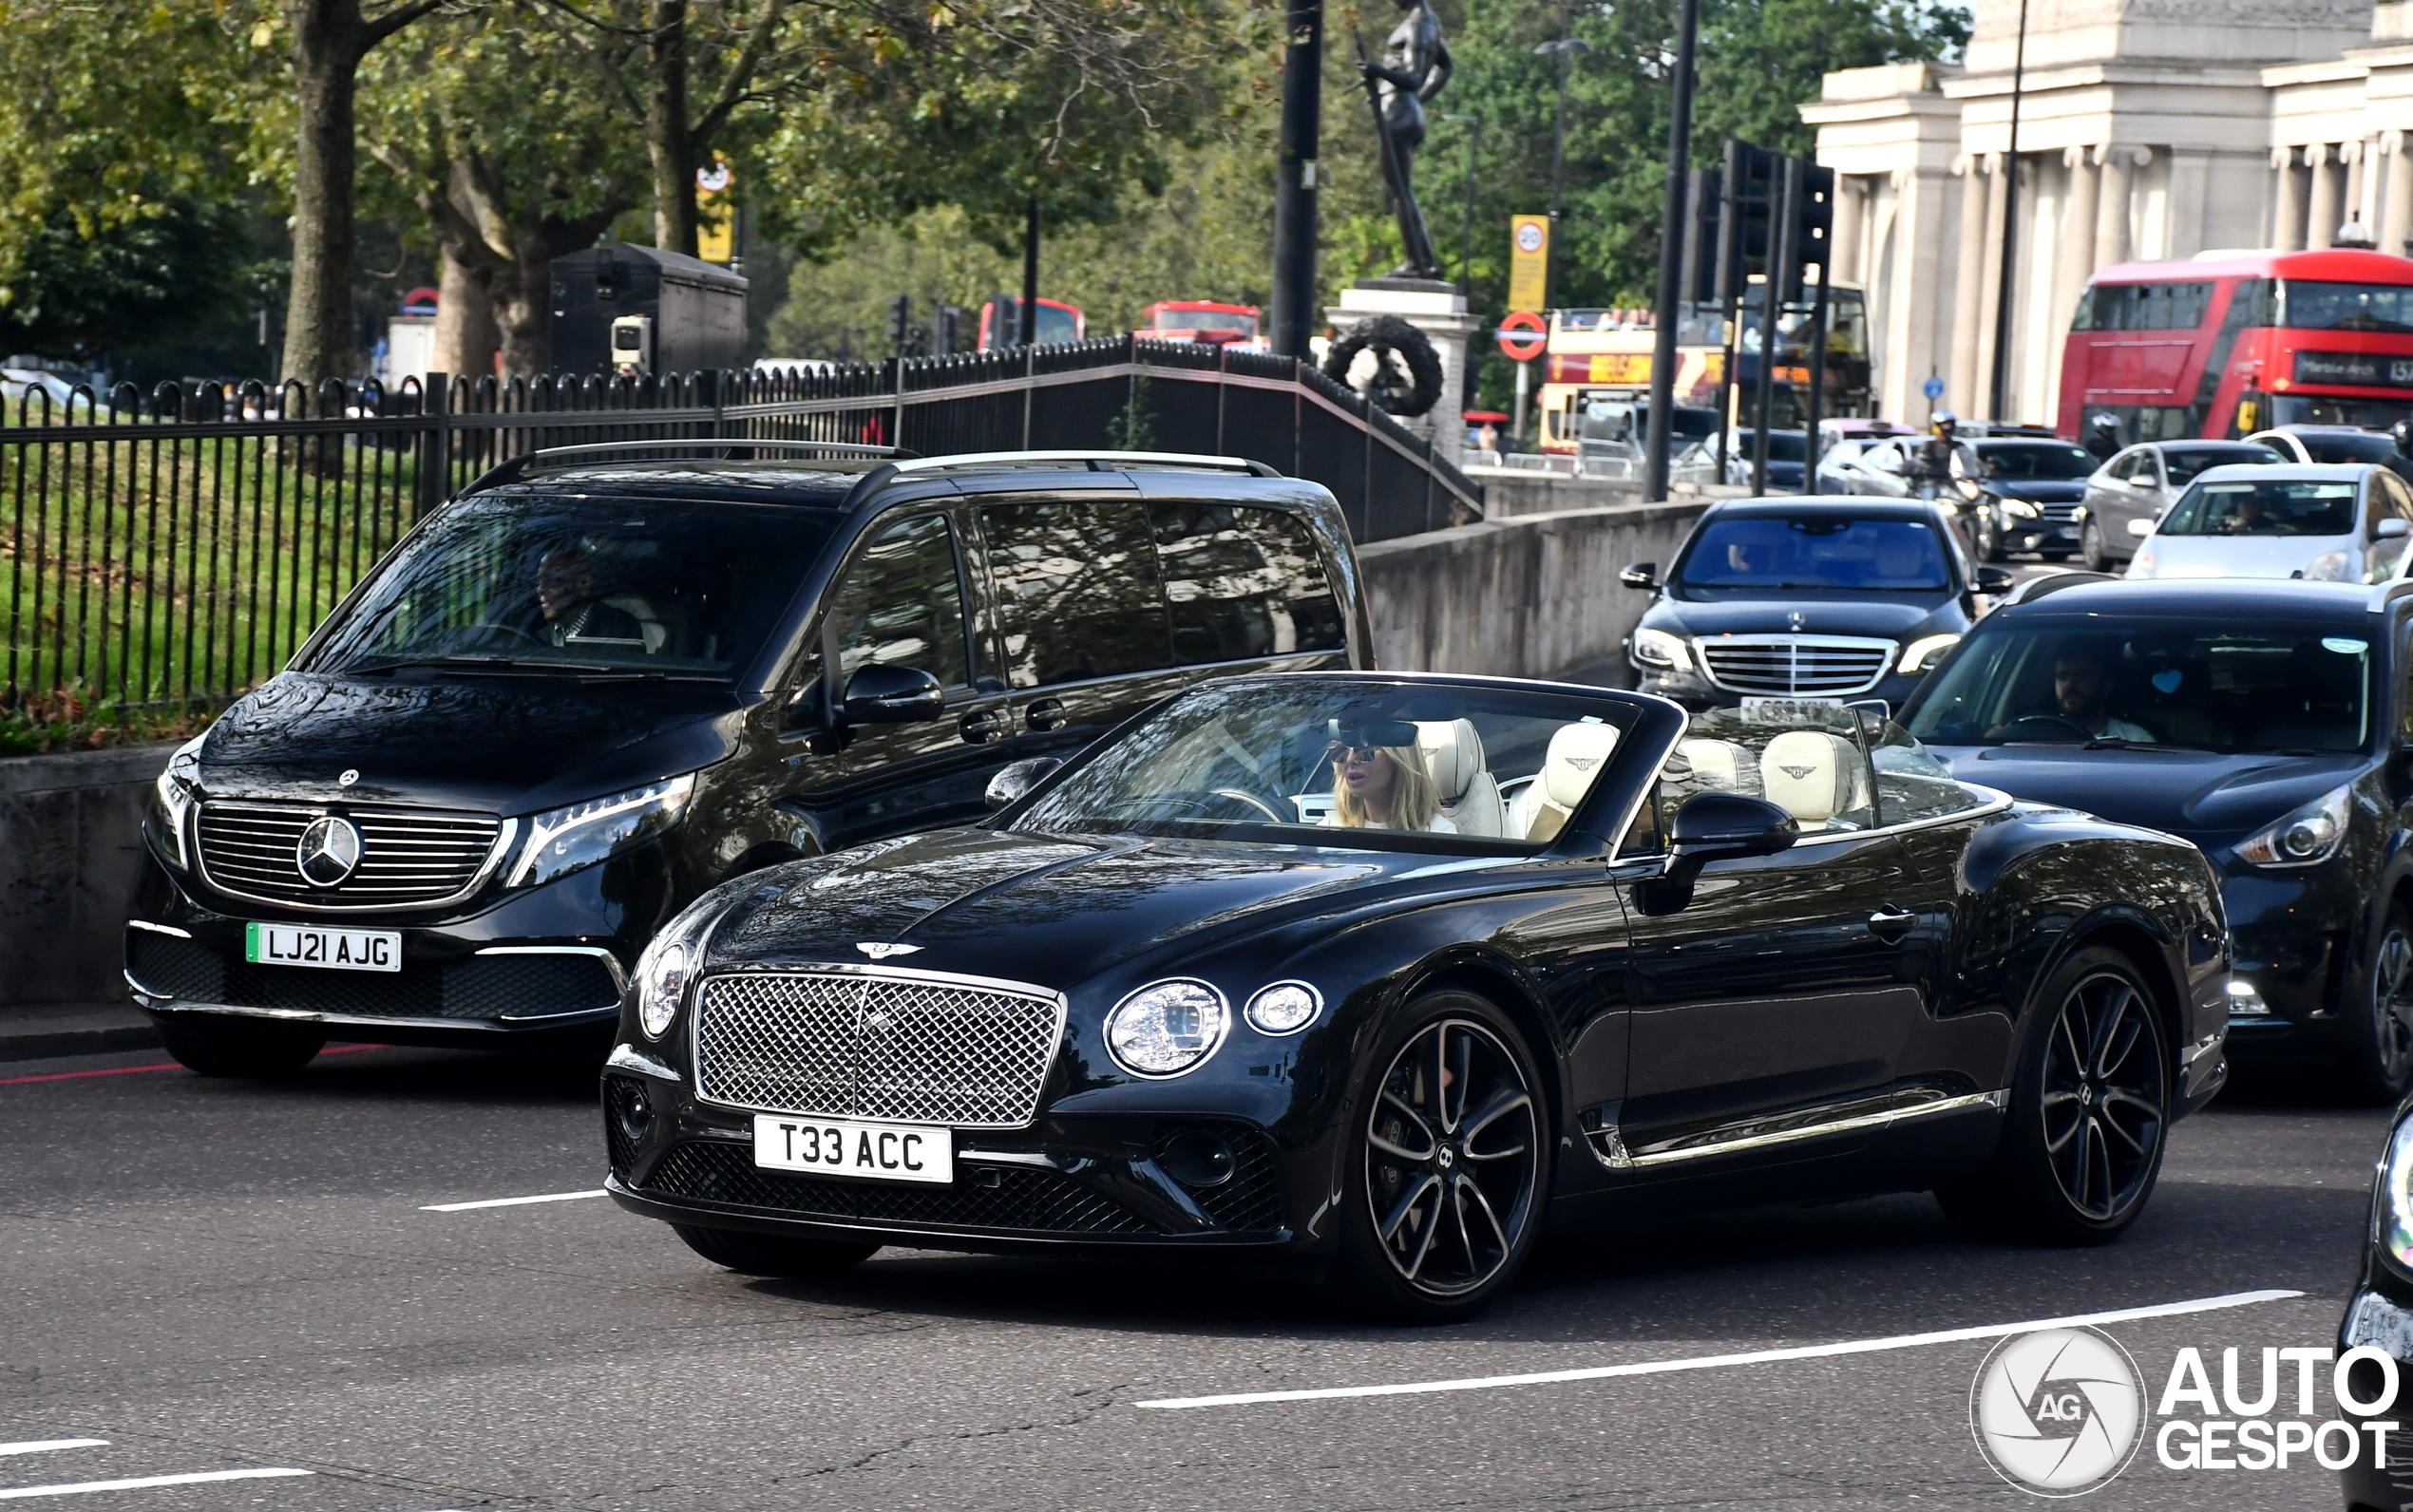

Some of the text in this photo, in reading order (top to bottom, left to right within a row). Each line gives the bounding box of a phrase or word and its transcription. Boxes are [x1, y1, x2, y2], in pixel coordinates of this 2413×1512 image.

[269, 930, 389, 965] LJ21 AJG
[779, 1124, 924, 1171] T33 ACC
